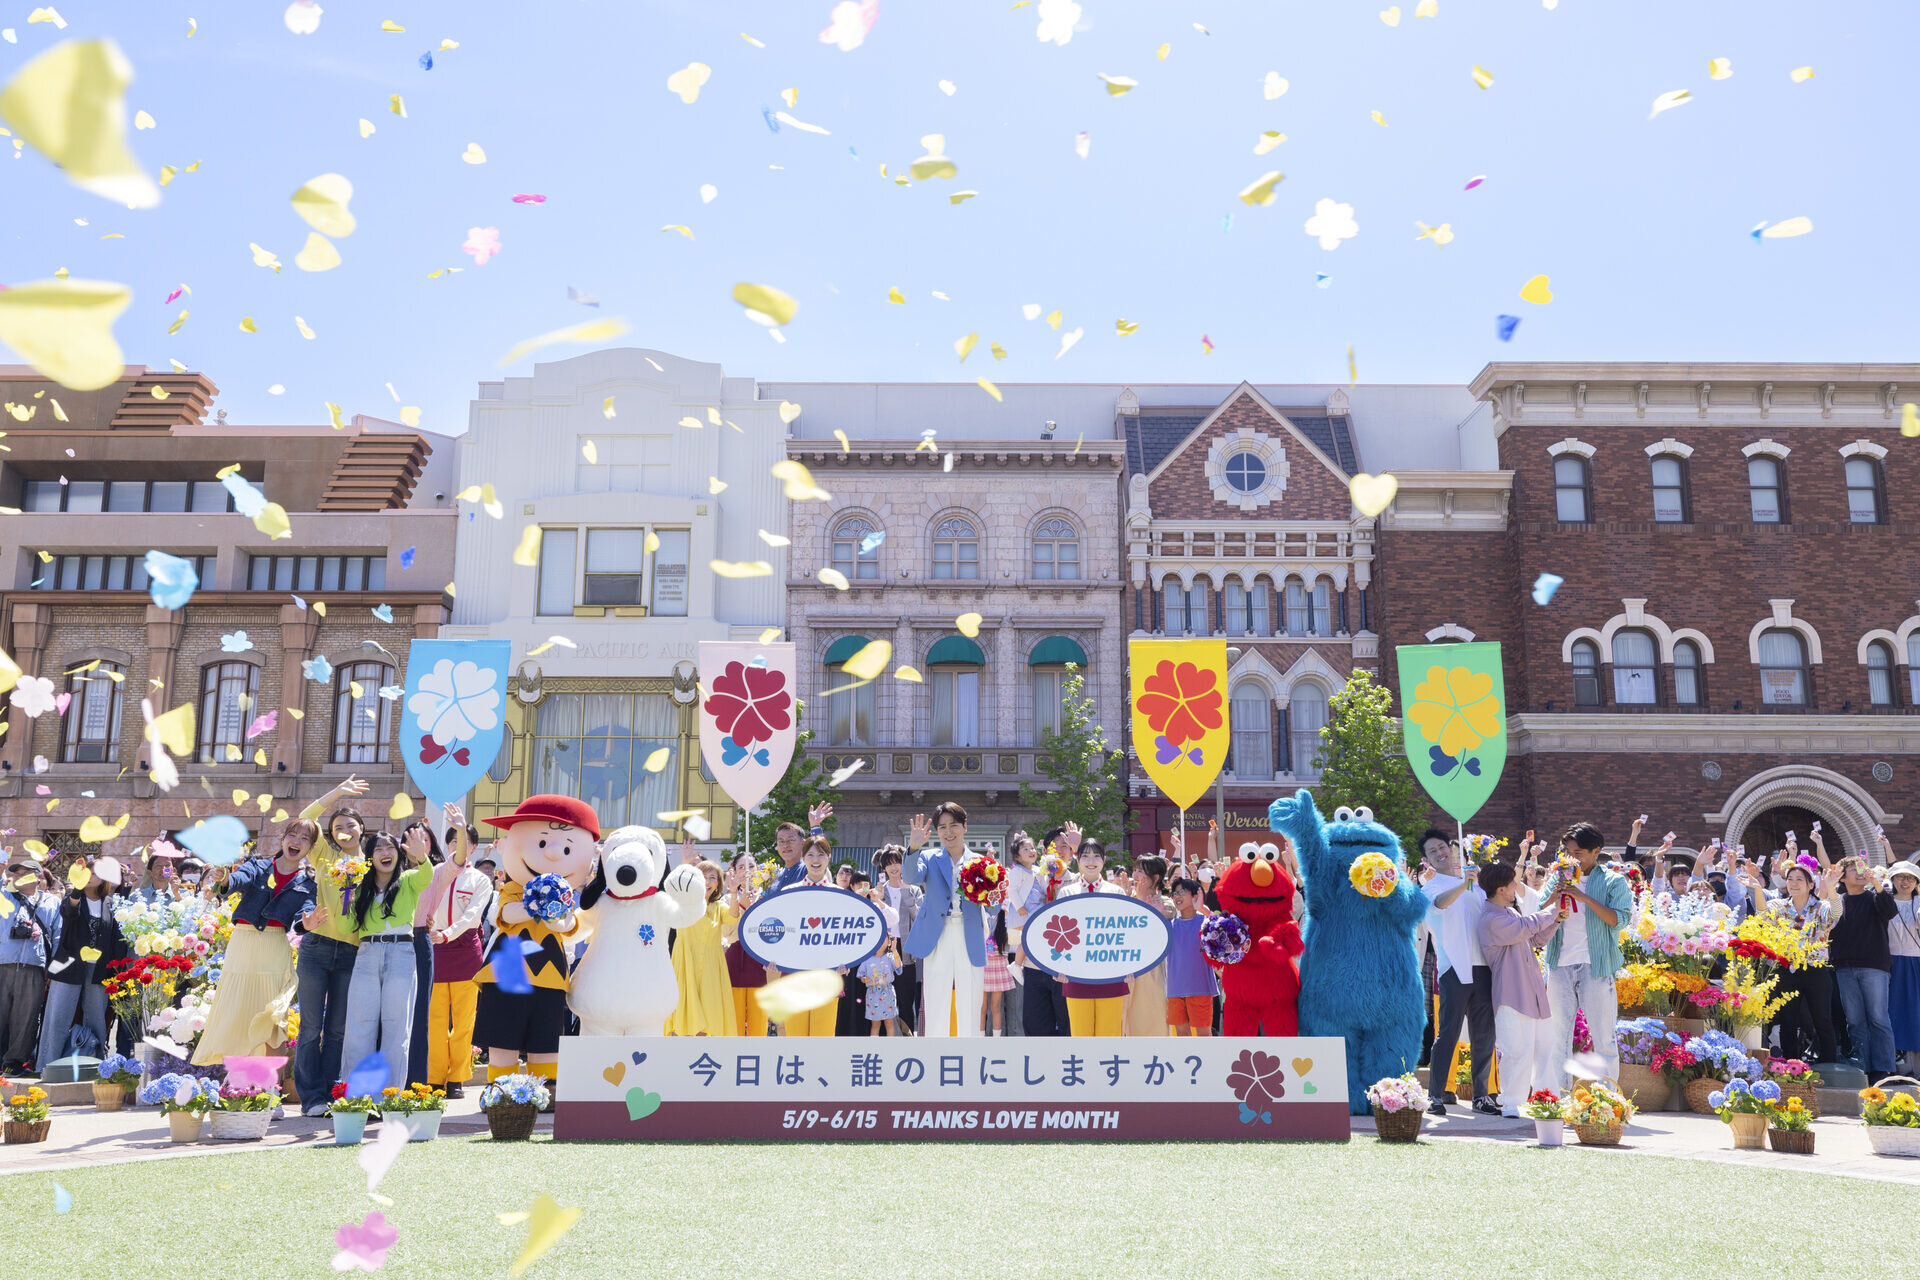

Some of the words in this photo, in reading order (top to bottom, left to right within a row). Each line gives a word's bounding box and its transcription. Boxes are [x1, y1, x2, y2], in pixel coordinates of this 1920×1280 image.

[571, 641, 648, 659] PACIFIC
[843, 917, 875, 929] HAS
[1085, 915, 1148, 929] THANKS
[799, 933, 823, 946] NO
[824, 933, 866, 945] LIMIT
[1085, 932, 1126, 946] LOVE
[1085, 949, 1142, 962] MONTH
[689, 1052, 1203, 1087] 今日は、誰の日にしますか？
[782, 1110, 879, 1129] 5/9-6/15
[891, 1111, 978, 1129] THANKS
[982, 1111, 1038, 1129] LOVE
[1041, 1111, 1120, 1129] MONTH
